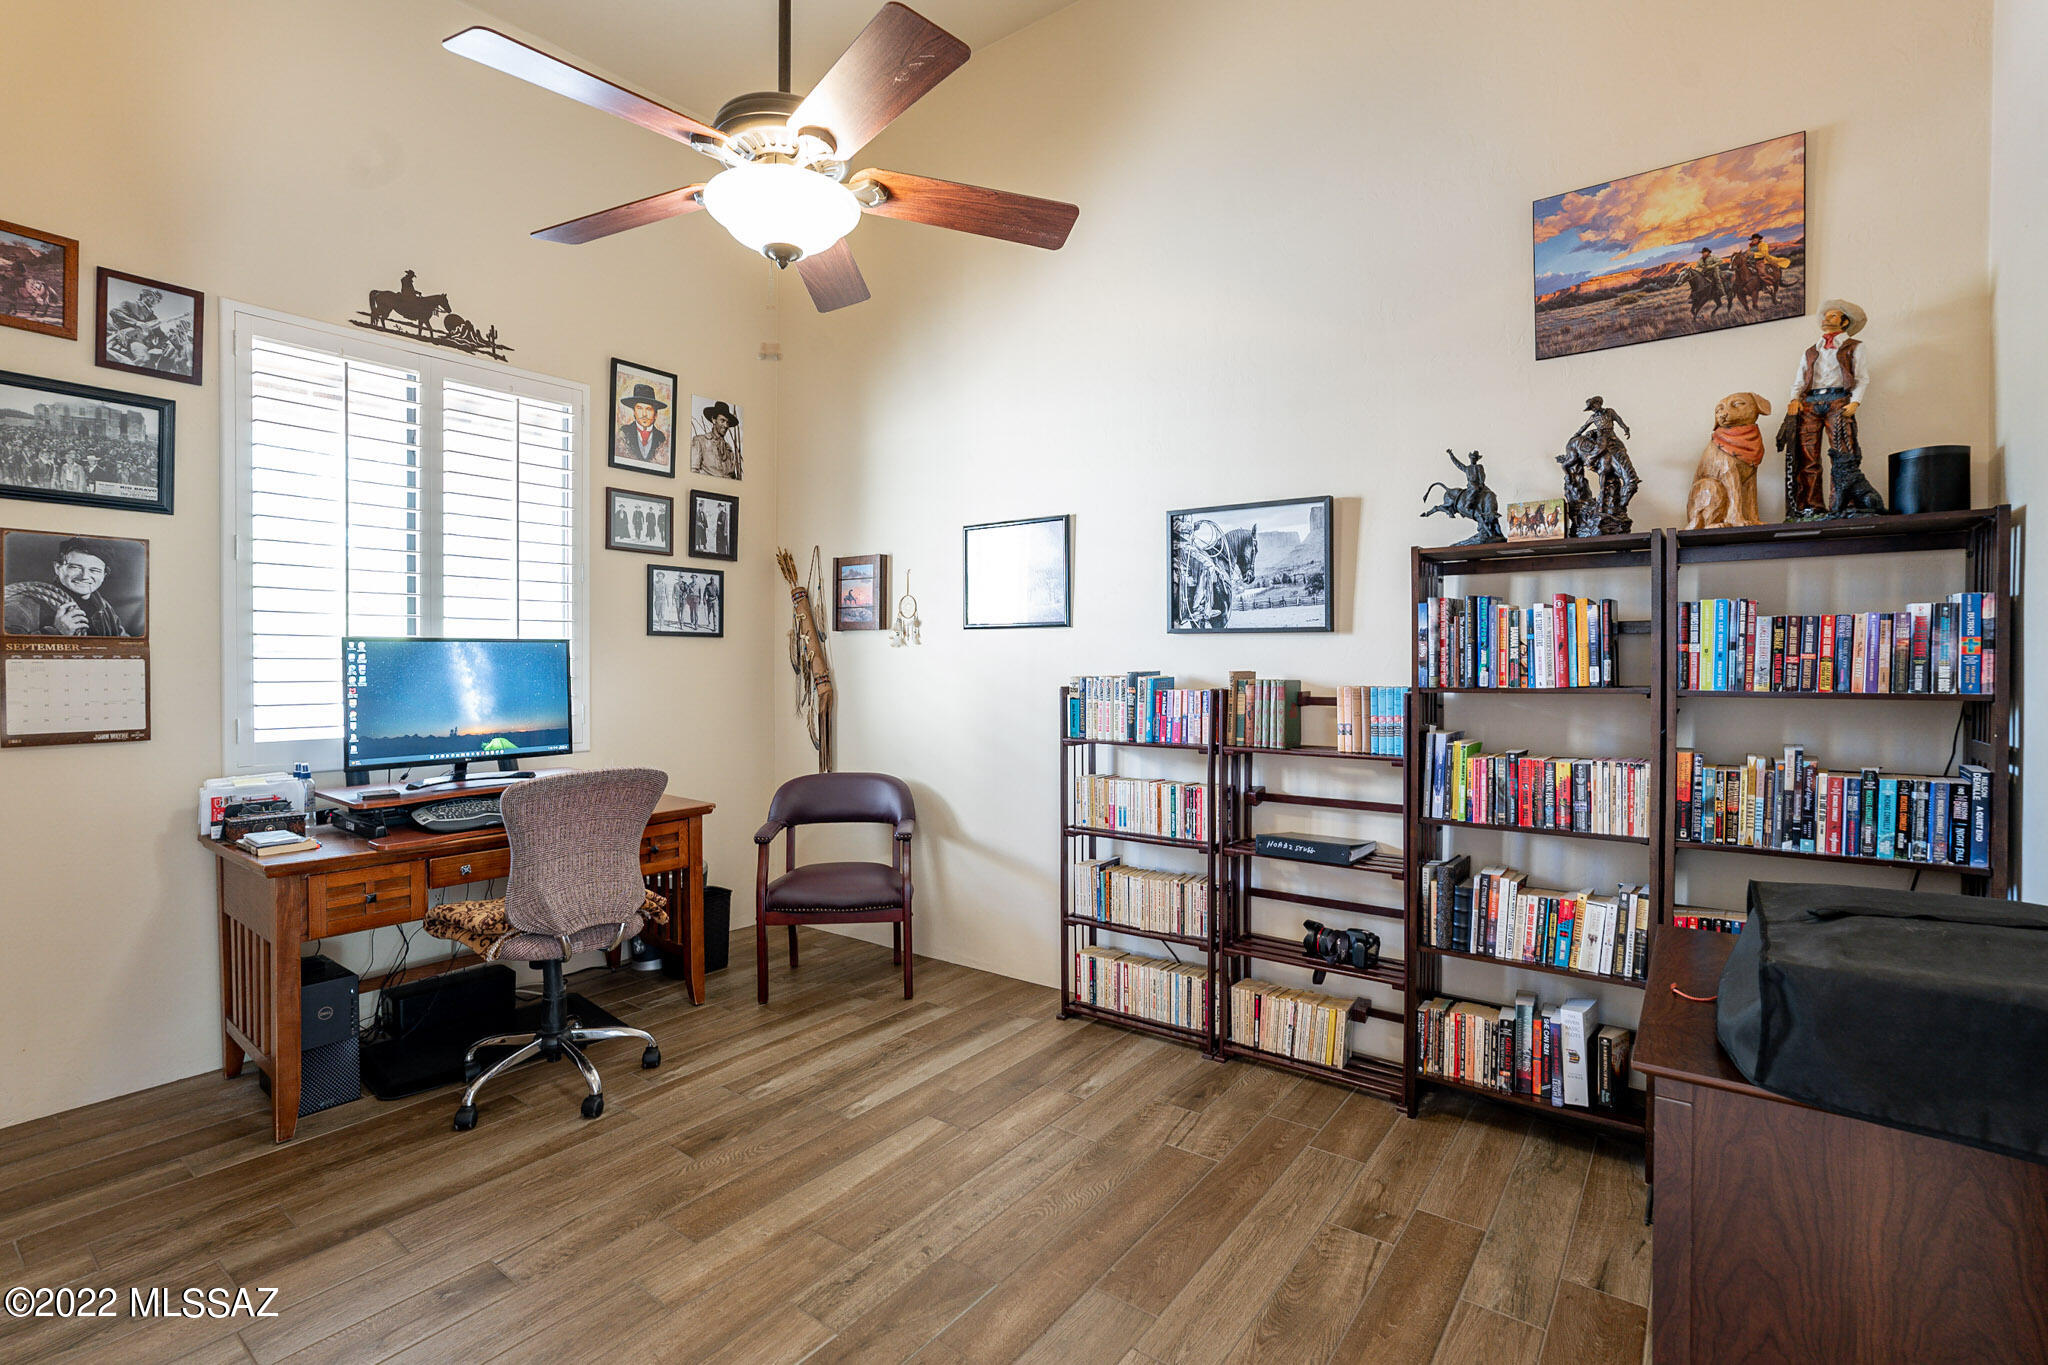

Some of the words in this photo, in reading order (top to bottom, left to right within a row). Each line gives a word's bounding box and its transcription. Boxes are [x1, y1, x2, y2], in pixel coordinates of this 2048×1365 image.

[1967, 612, 1975, 636] BURKE
[5, 643, 80, 651] SEPTEMBER
[1972, 772, 1981, 801] DEMILLE
[1981, 776, 1989, 798] NELSON
[1694, 791, 1702, 807] OPEN
[1694, 808, 1702, 833] SEASON
[1975, 811, 1984, 829] QUIET
[1955, 827, 1965, 847] NIGHT
[1975, 829, 1984, 842] END
[1955, 847, 1965, 862] FALL
